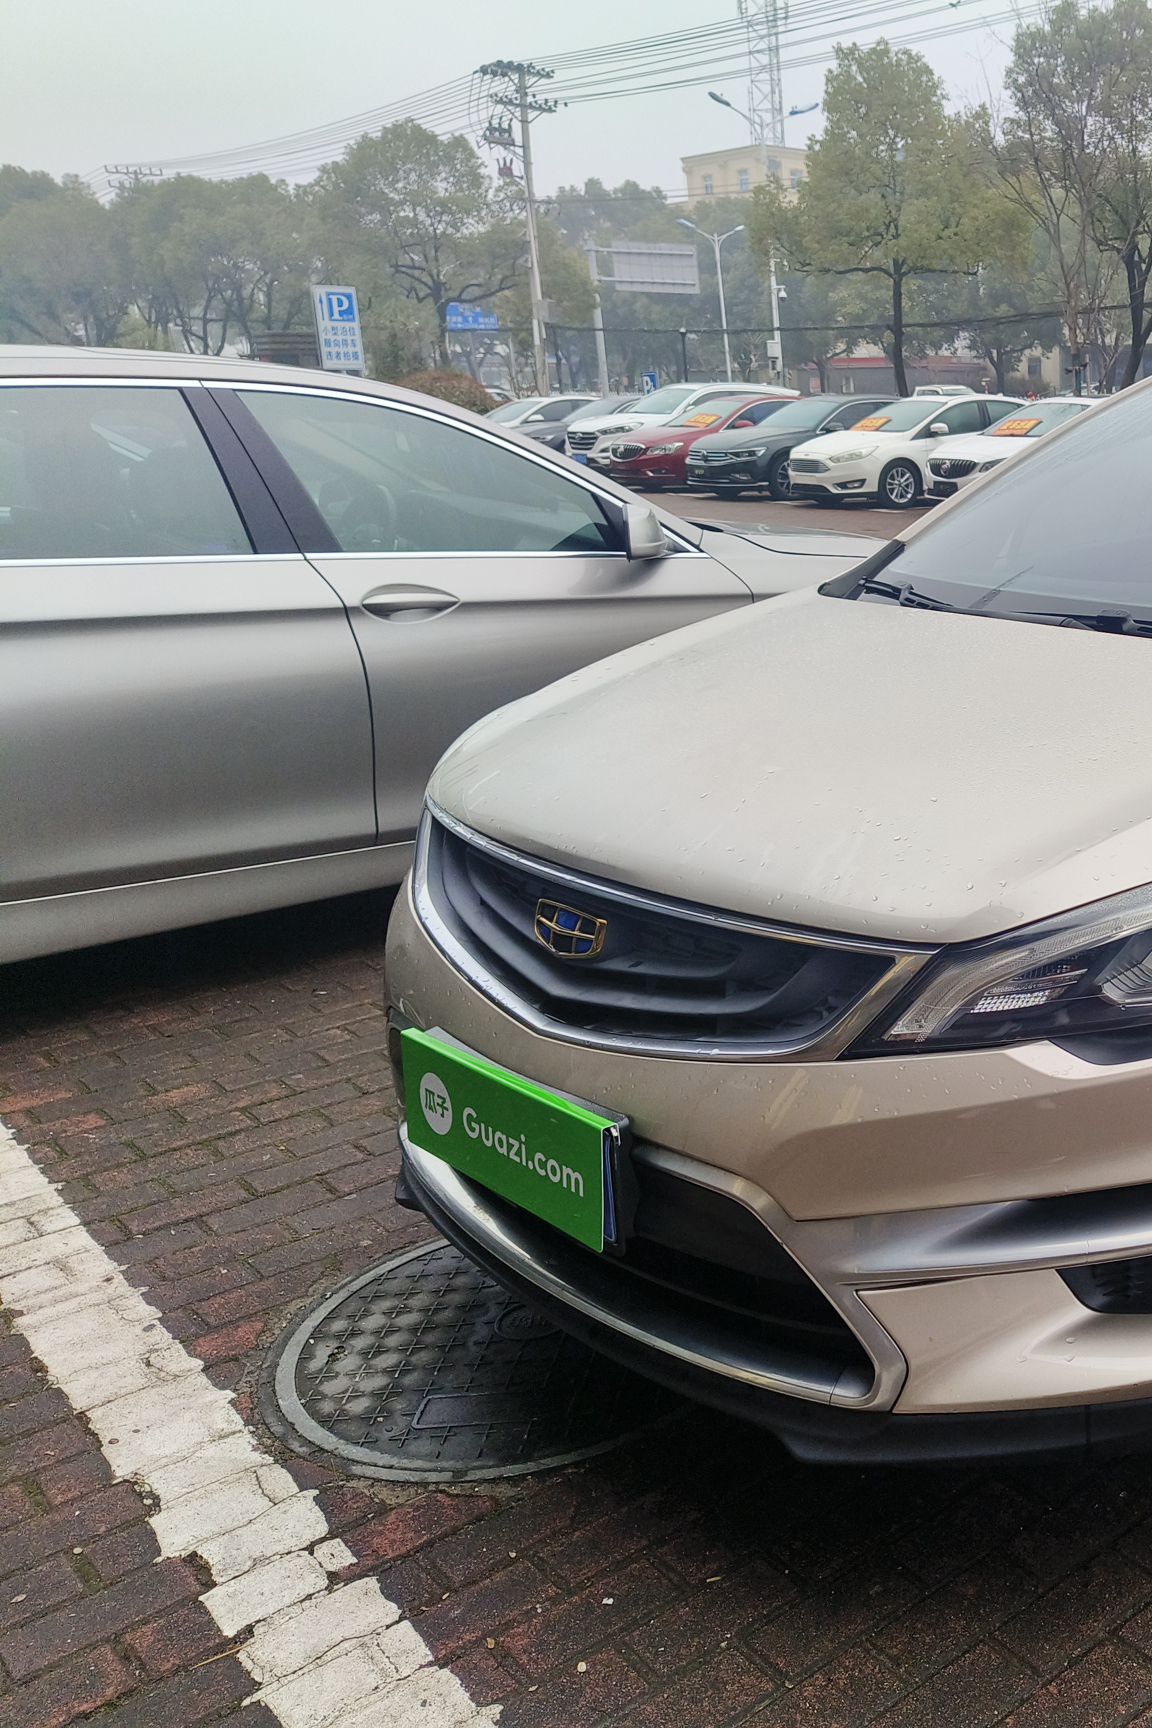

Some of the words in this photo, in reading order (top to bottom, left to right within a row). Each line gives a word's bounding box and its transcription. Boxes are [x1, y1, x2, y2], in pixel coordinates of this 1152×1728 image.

[328, 295, 349, 320] P
[424, 1087, 449, 1119] 瓜子
[463, 1107, 584, 1198] Guazi.com
